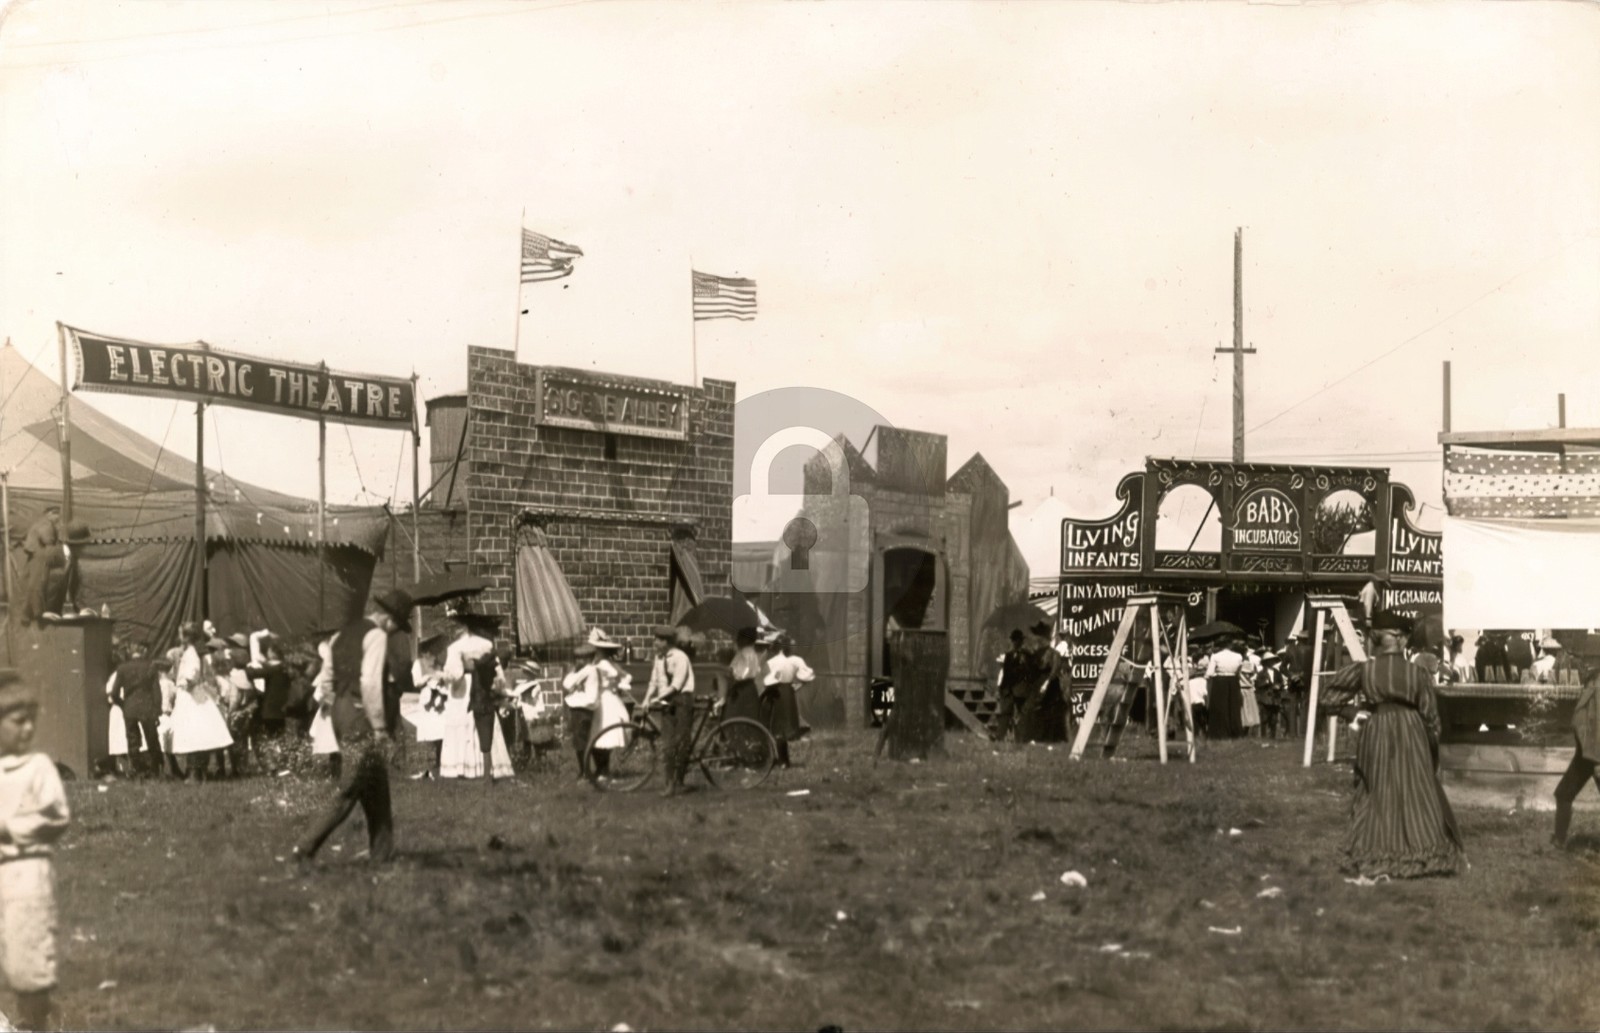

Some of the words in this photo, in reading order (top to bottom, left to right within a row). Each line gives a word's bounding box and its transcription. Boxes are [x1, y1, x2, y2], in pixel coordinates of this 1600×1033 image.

[106, 345, 254, 397] ELECTRIC
[1247, 496, 1293, 524] BABY
[1067, 511, 1139, 550] LIVING
[1234, 529, 1299, 546] INCUBATORS
[1068, 551, 1139, 567] INFANTS
[1063, 607, 1125, 637] HUMANIT
[1070, 644, 1110, 656] ROCESS
